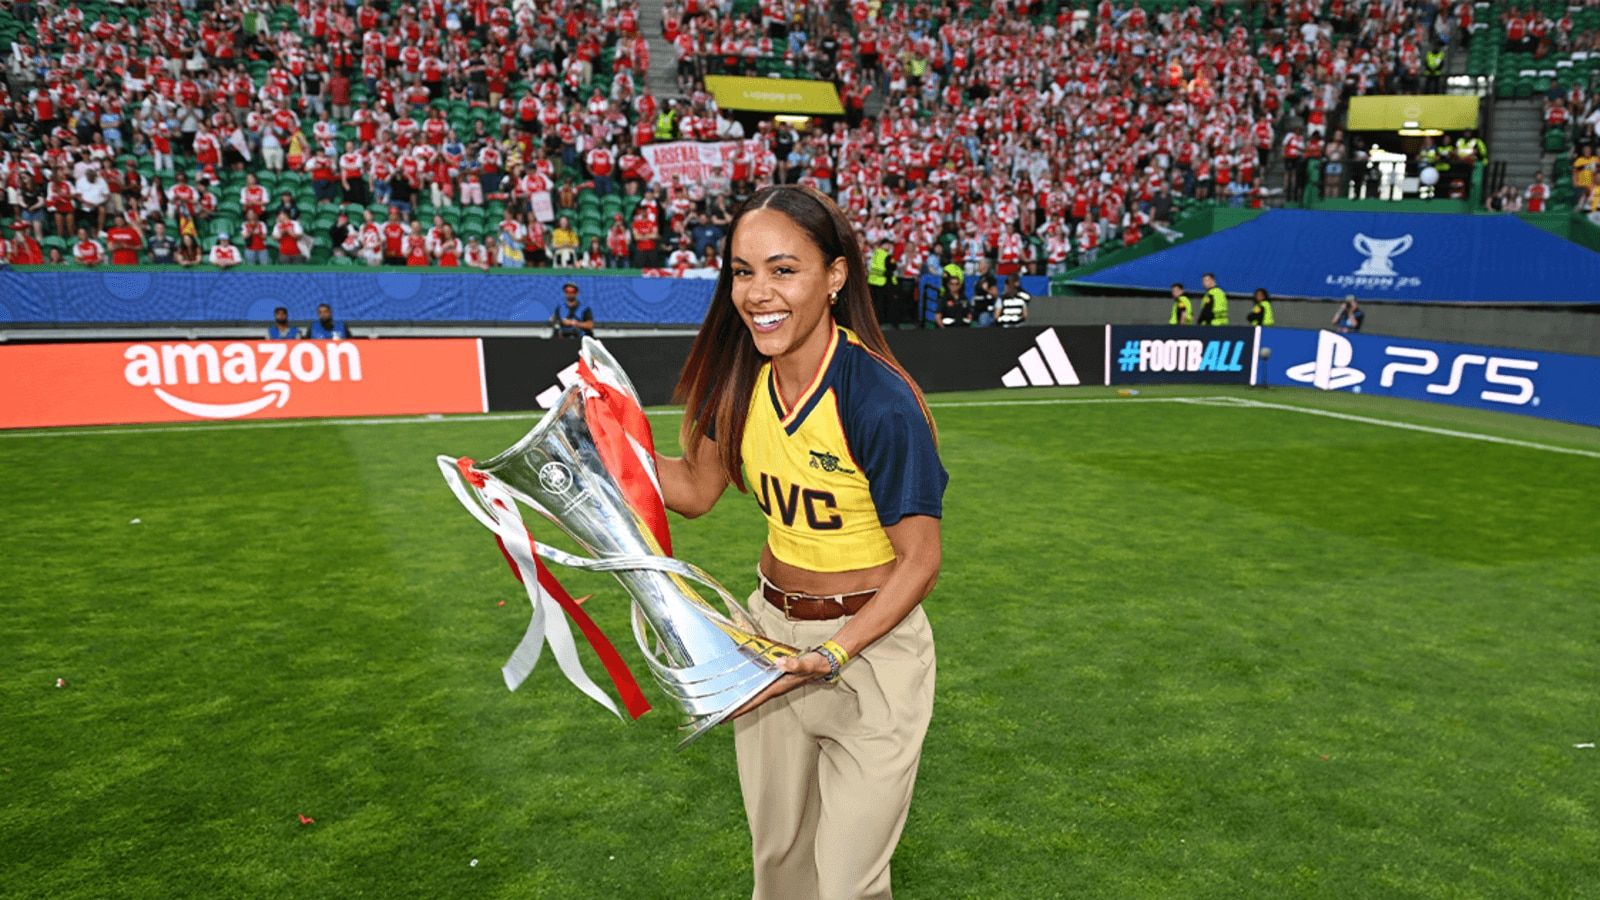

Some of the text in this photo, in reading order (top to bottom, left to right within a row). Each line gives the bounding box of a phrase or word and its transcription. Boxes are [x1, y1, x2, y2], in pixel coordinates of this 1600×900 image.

[1325, 274, 1394, 289] LISBON
[123, 341, 363, 387] amazon
[1118, 339, 1245, 372] #FOOTBALL
[1379, 345, 1540, 405] PS5
[753, 471, 843, 530] JVC
